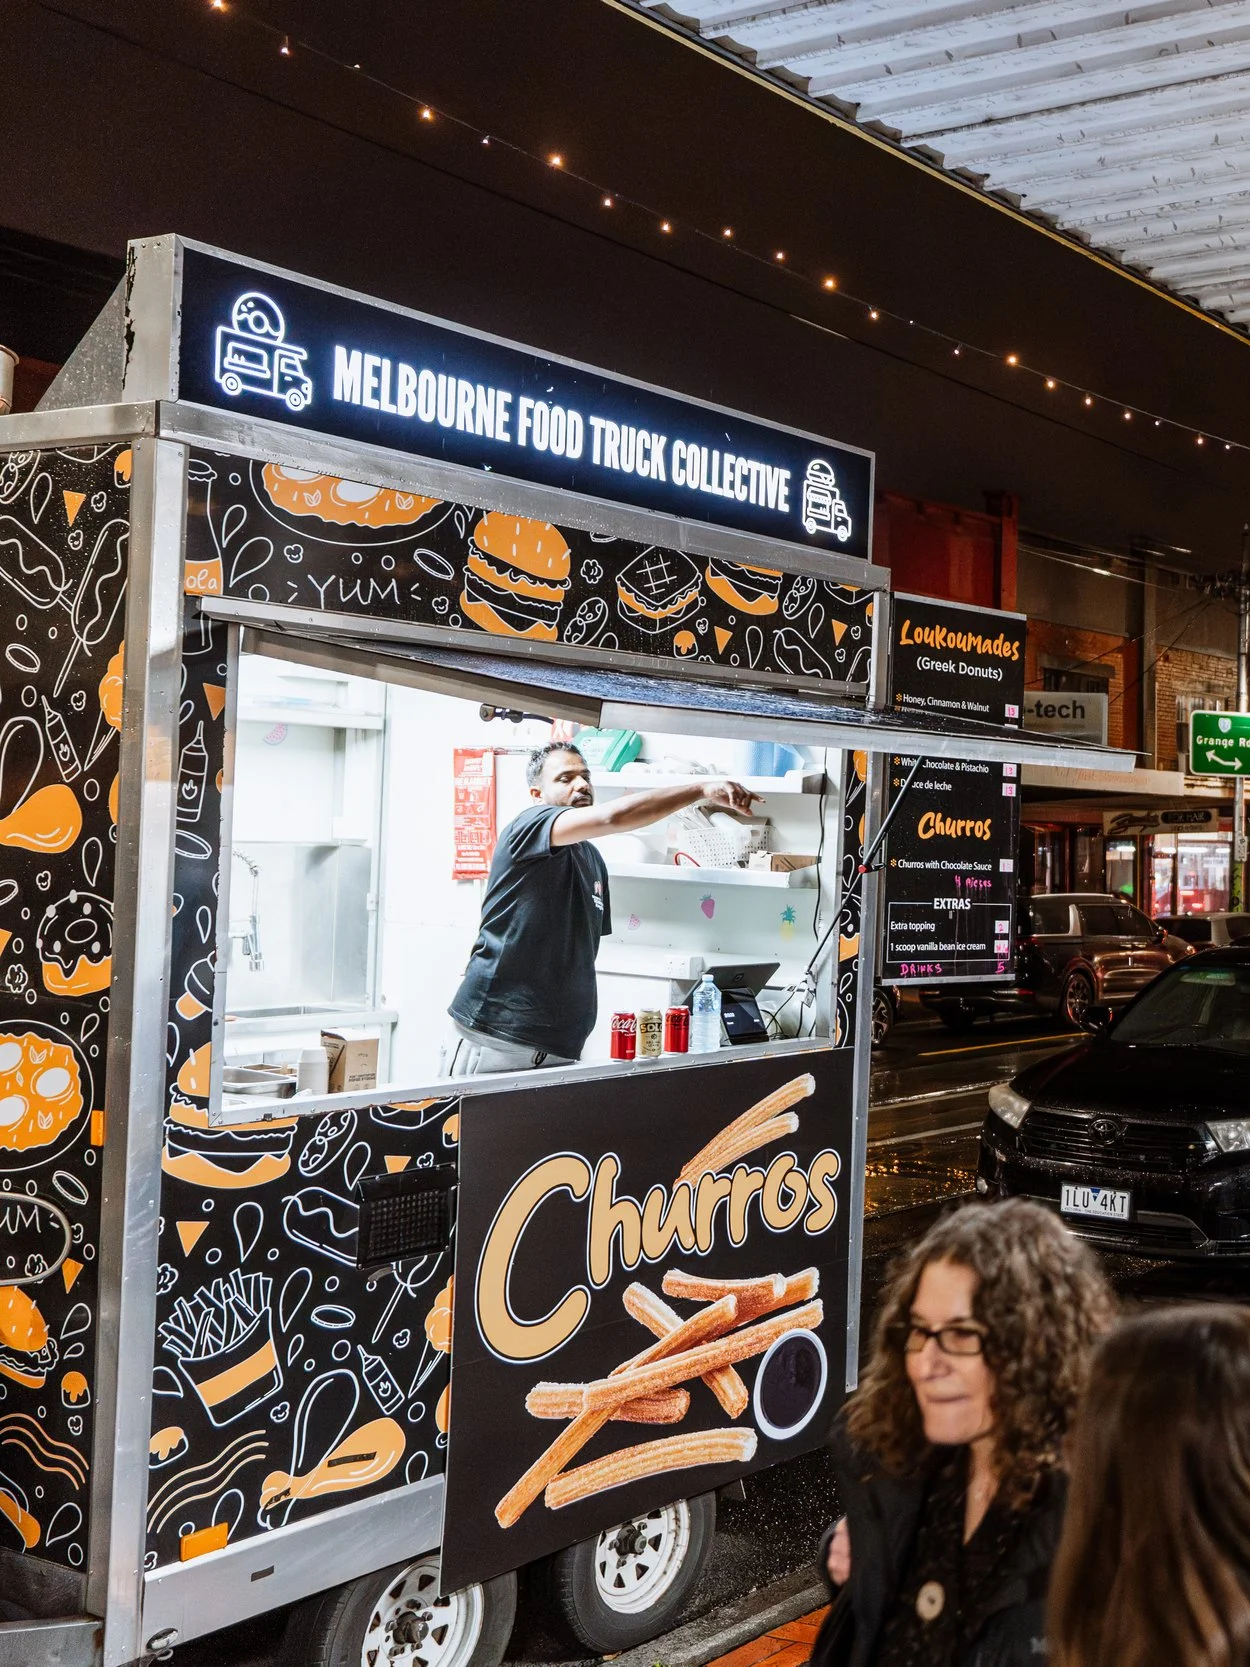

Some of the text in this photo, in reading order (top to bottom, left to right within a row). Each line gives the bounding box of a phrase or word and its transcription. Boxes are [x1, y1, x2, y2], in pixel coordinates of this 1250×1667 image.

[333, 345, 791, 512] MELBOURNE FOOD TRUCK COLLECTIVE
[307, 574, 400, 610] YUM
[916, 656, 1003, 681] (Greek Donuts)
[903, 694, 990, 713] Honey, Cinnamon & Walnut
[1024, 699, 1086, 719] -tech
[1196, 735, 1234, 749] Grange
[901, 757, 919, 767] Whit
[955, 762, 960, 771] &
[961, 763, 989, 773] Pistachio
[924, 780, 933, 789] de
[934, 780, 952, 791] leche
[917, 811, 992, 841] Churros
[898, 859, 992, 871] Churros with Chocolate Sauce
[933, 898, 971, 910] EXTRAS
[890, 921, 936, 932] Extra topping
[895, 943, 916, 952] scoop
[917, 942, 938, 951] vanilla
[939, 942, 955, 951] bean
[957, 942, 966, 950] ice
[900, 963, 942, 976] DRINKS
[996, 961, 1005, 974] 5
[1066, 1189, 1126, 1213] 1LU 4KT
[474, 1147, 842, 1364] Churros
